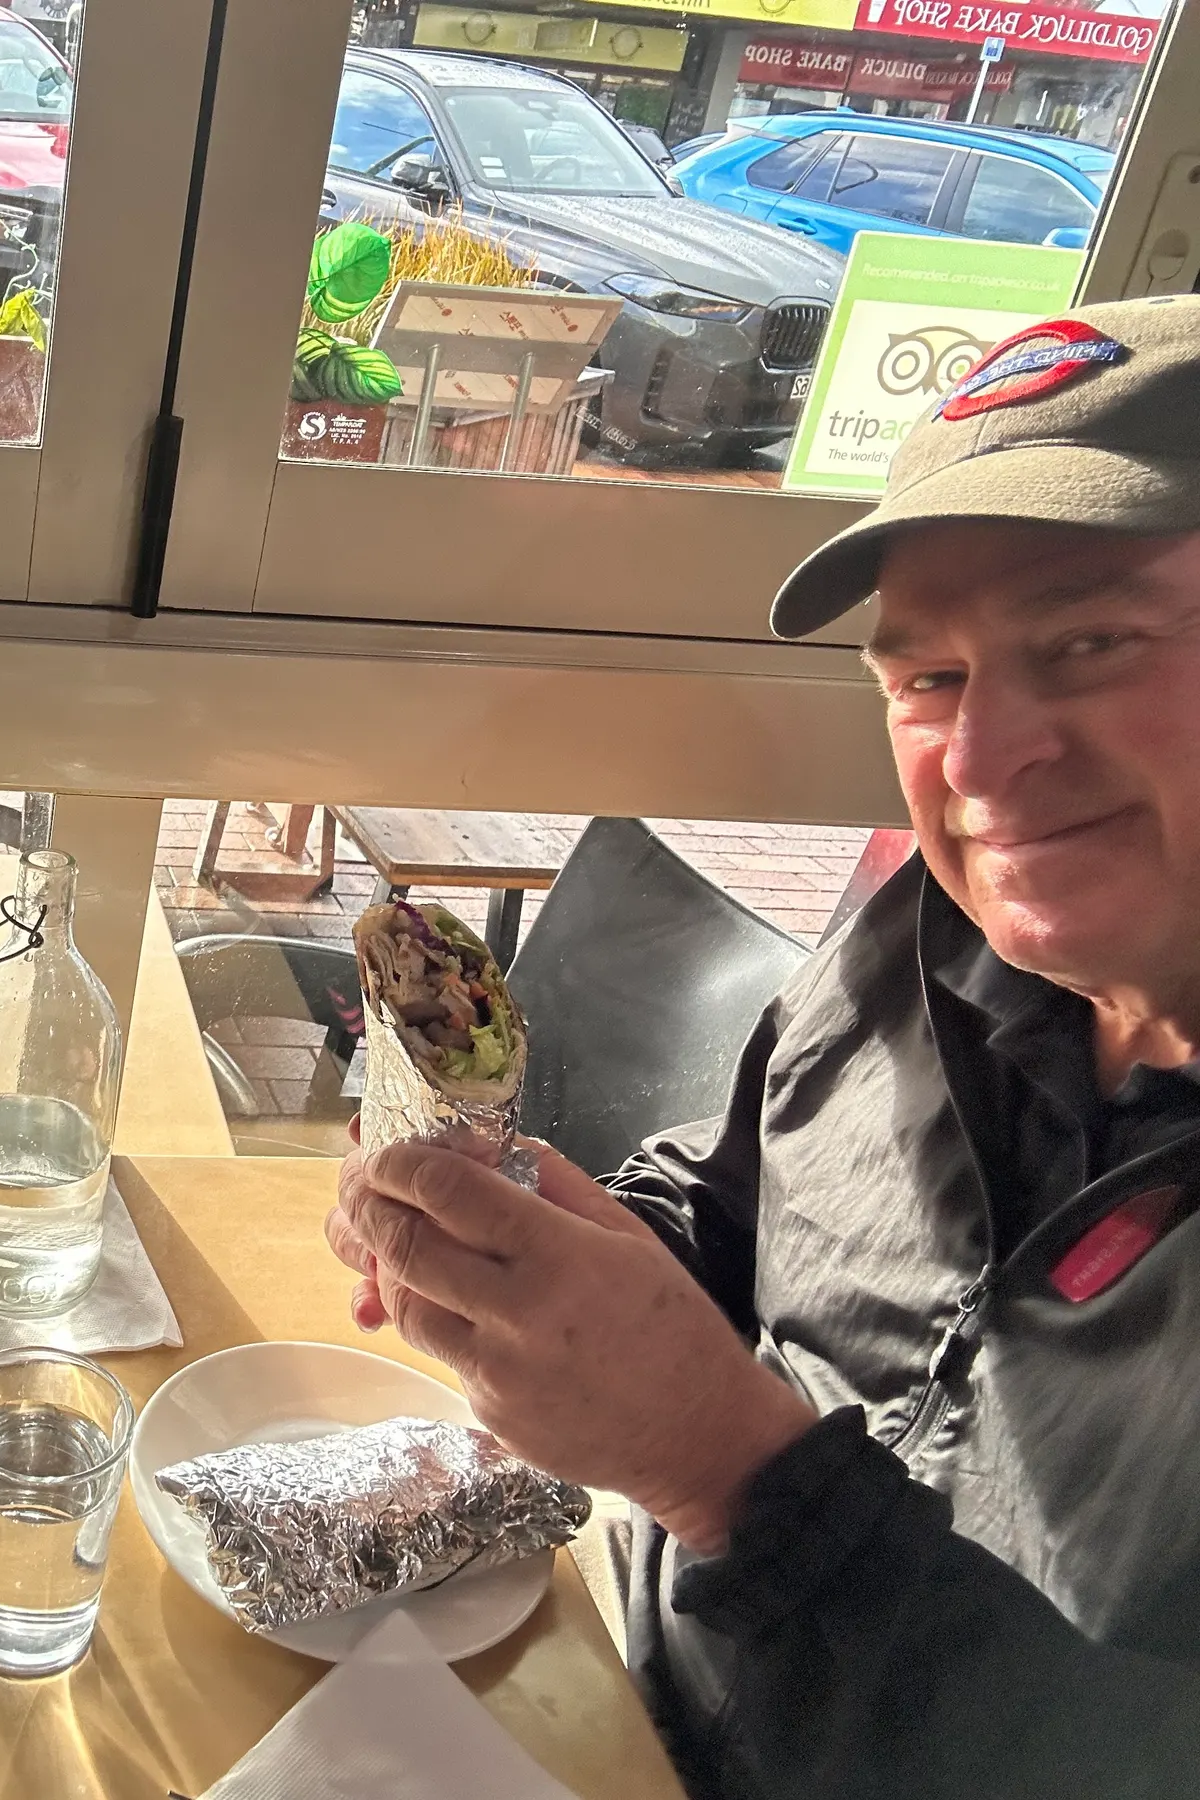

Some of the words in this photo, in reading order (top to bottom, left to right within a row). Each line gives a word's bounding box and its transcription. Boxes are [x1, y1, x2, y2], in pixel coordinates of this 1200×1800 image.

[862, 263, 949, 283] Recommended
[828, 448, 848, 460] The
[850, 450, 889, 464] world's
